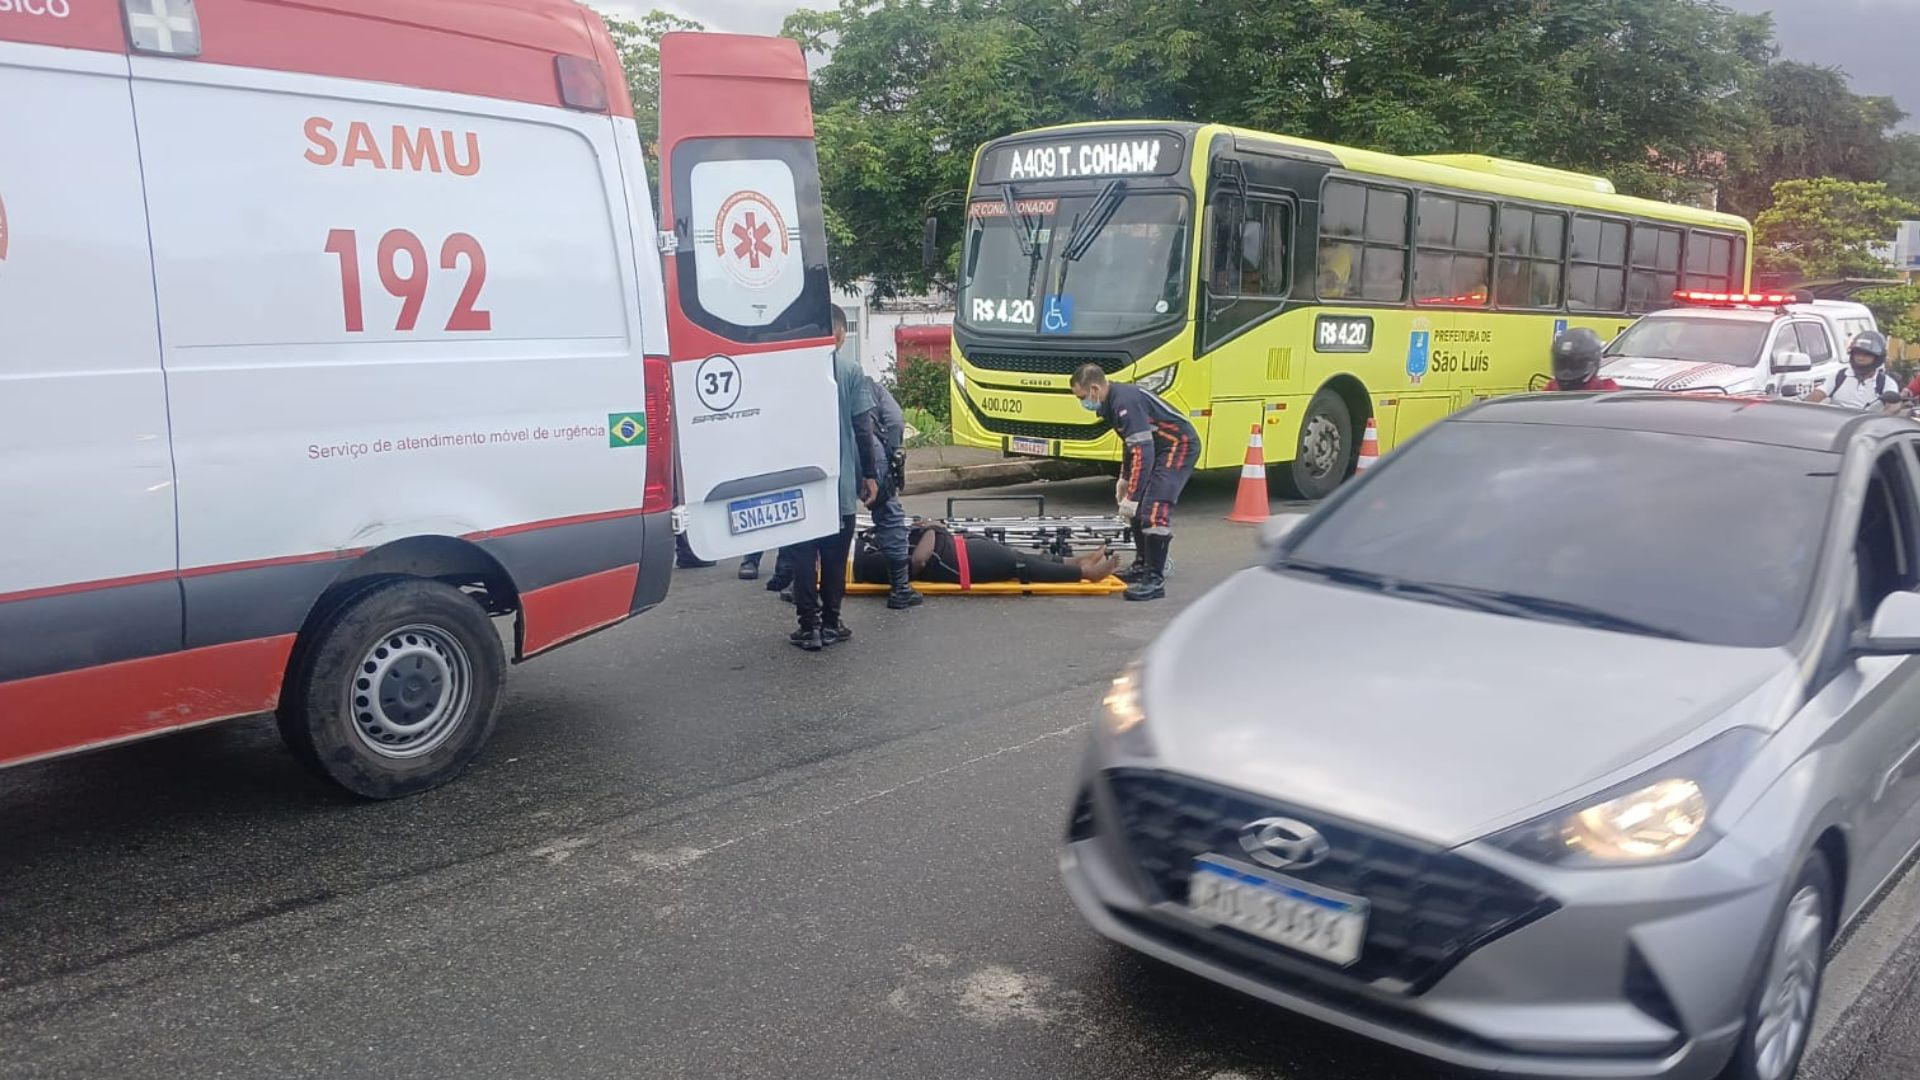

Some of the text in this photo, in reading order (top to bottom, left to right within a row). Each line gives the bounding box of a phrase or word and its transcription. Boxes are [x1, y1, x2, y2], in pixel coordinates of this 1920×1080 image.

[303, 116, 481, 176] SAMU
[1010, 148, 1056, 179] A409
[324, 228, 491, 332] 192
[973, 298, 995, 322] R$
[1320, 322, 1337, 345] R$
[1434, 329, 1492, 342] PREFEITURA DE
[1432, 350, 1490, 372] São Luís
[704, 371, 734, 395] 37
[691, 408, 761, 424] SPRINTER
[982, 397, 1023, 414] 400.020
[308, 424, 605, 460] Serviço de atendimento móvel de urgência
